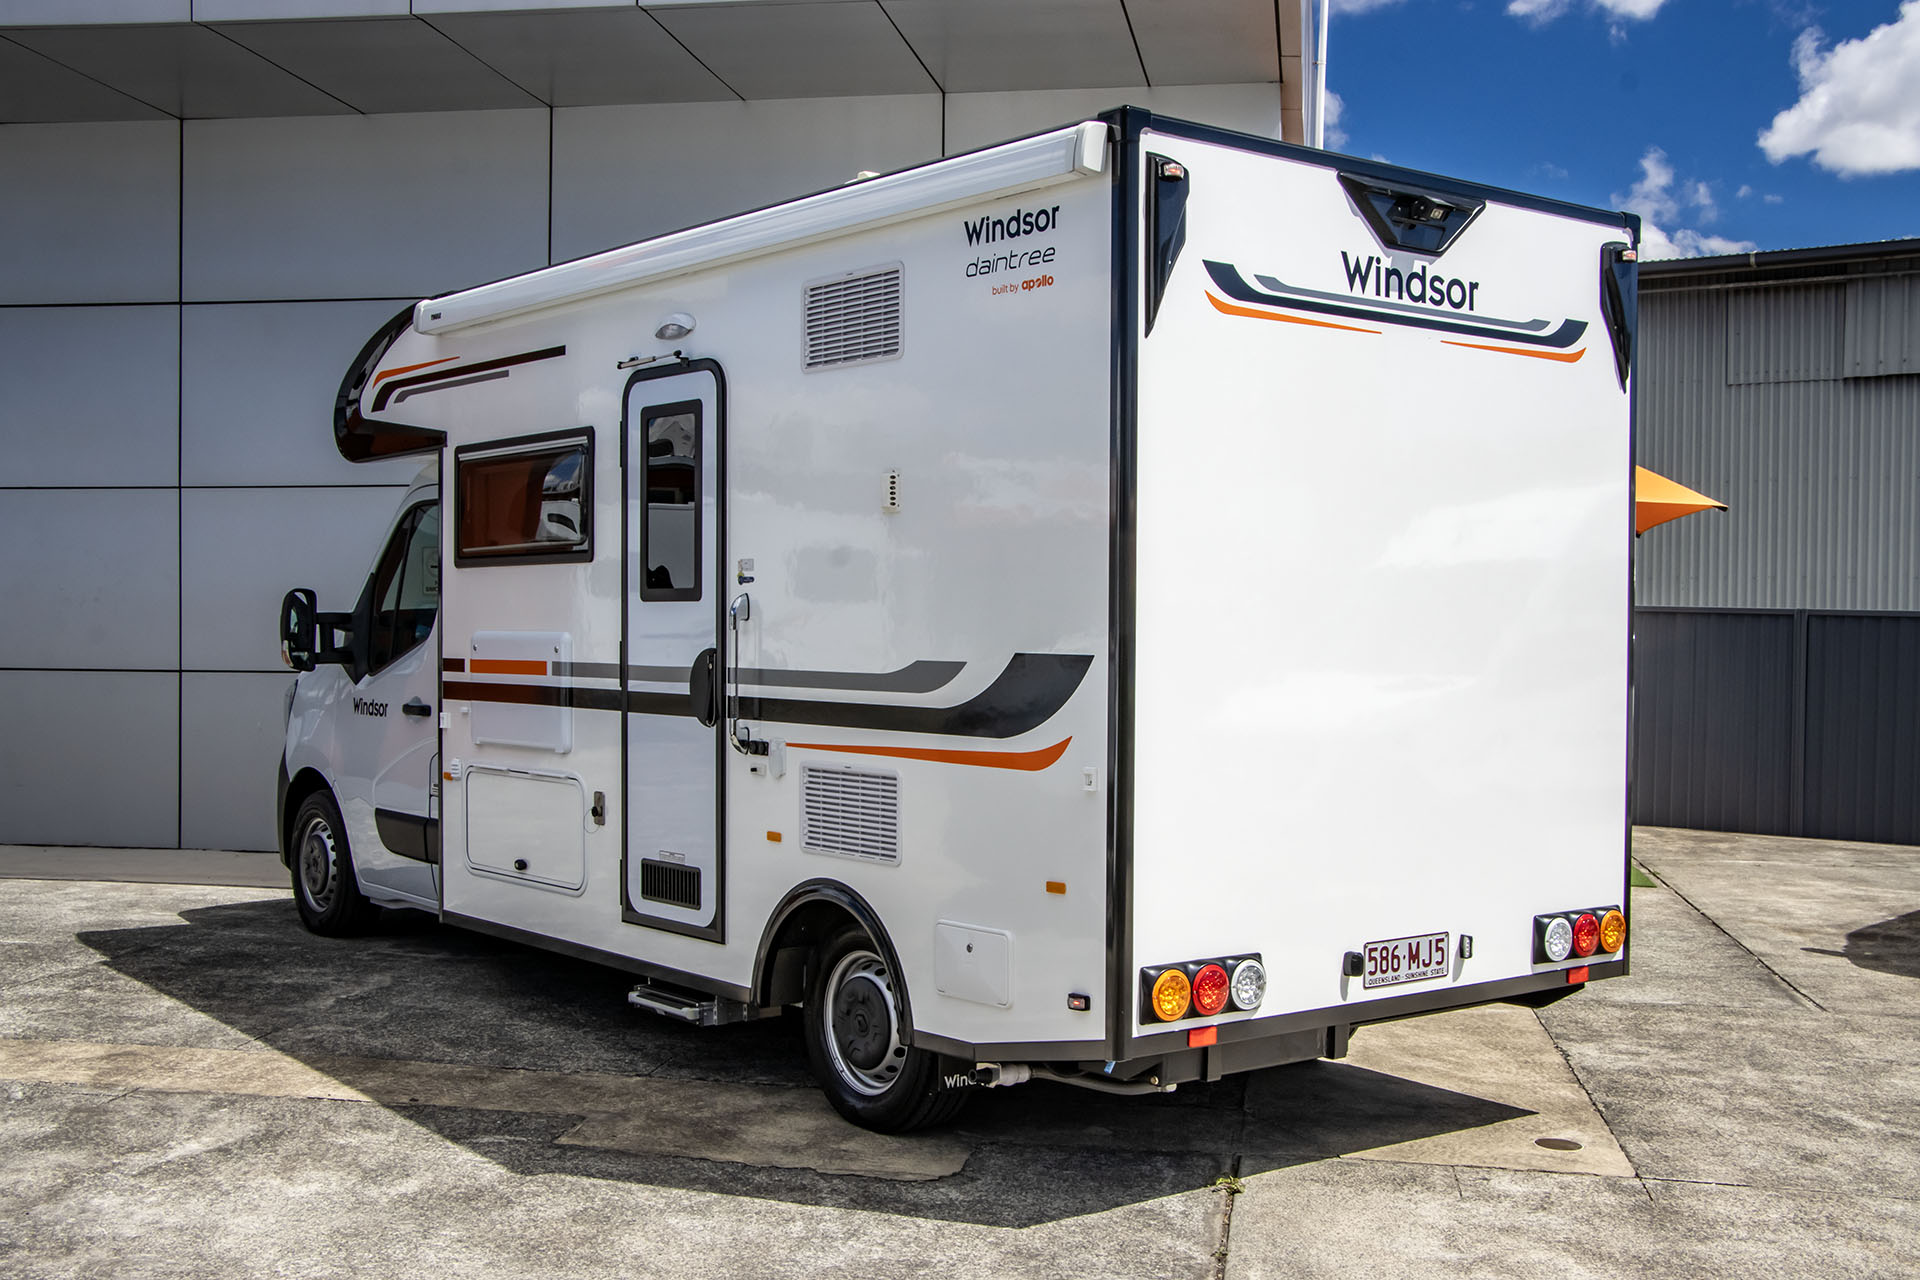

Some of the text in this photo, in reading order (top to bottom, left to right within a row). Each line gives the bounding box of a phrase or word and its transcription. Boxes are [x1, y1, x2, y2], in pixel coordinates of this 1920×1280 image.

[964, 205, 1060, 247] Windsor
[966, 247, 1055, 277] daintree
[992, 274, 1054, 296] built by apollo
[1341, 250, 1479, 311] Windsor
[353, 697, 389, 717] Windsor
[1368, 974, 1401, 986] QUEENSLAND
[1404, 969, 1429, 980] SUNSHINE
[1430, 967, 1445, 976] STATE
